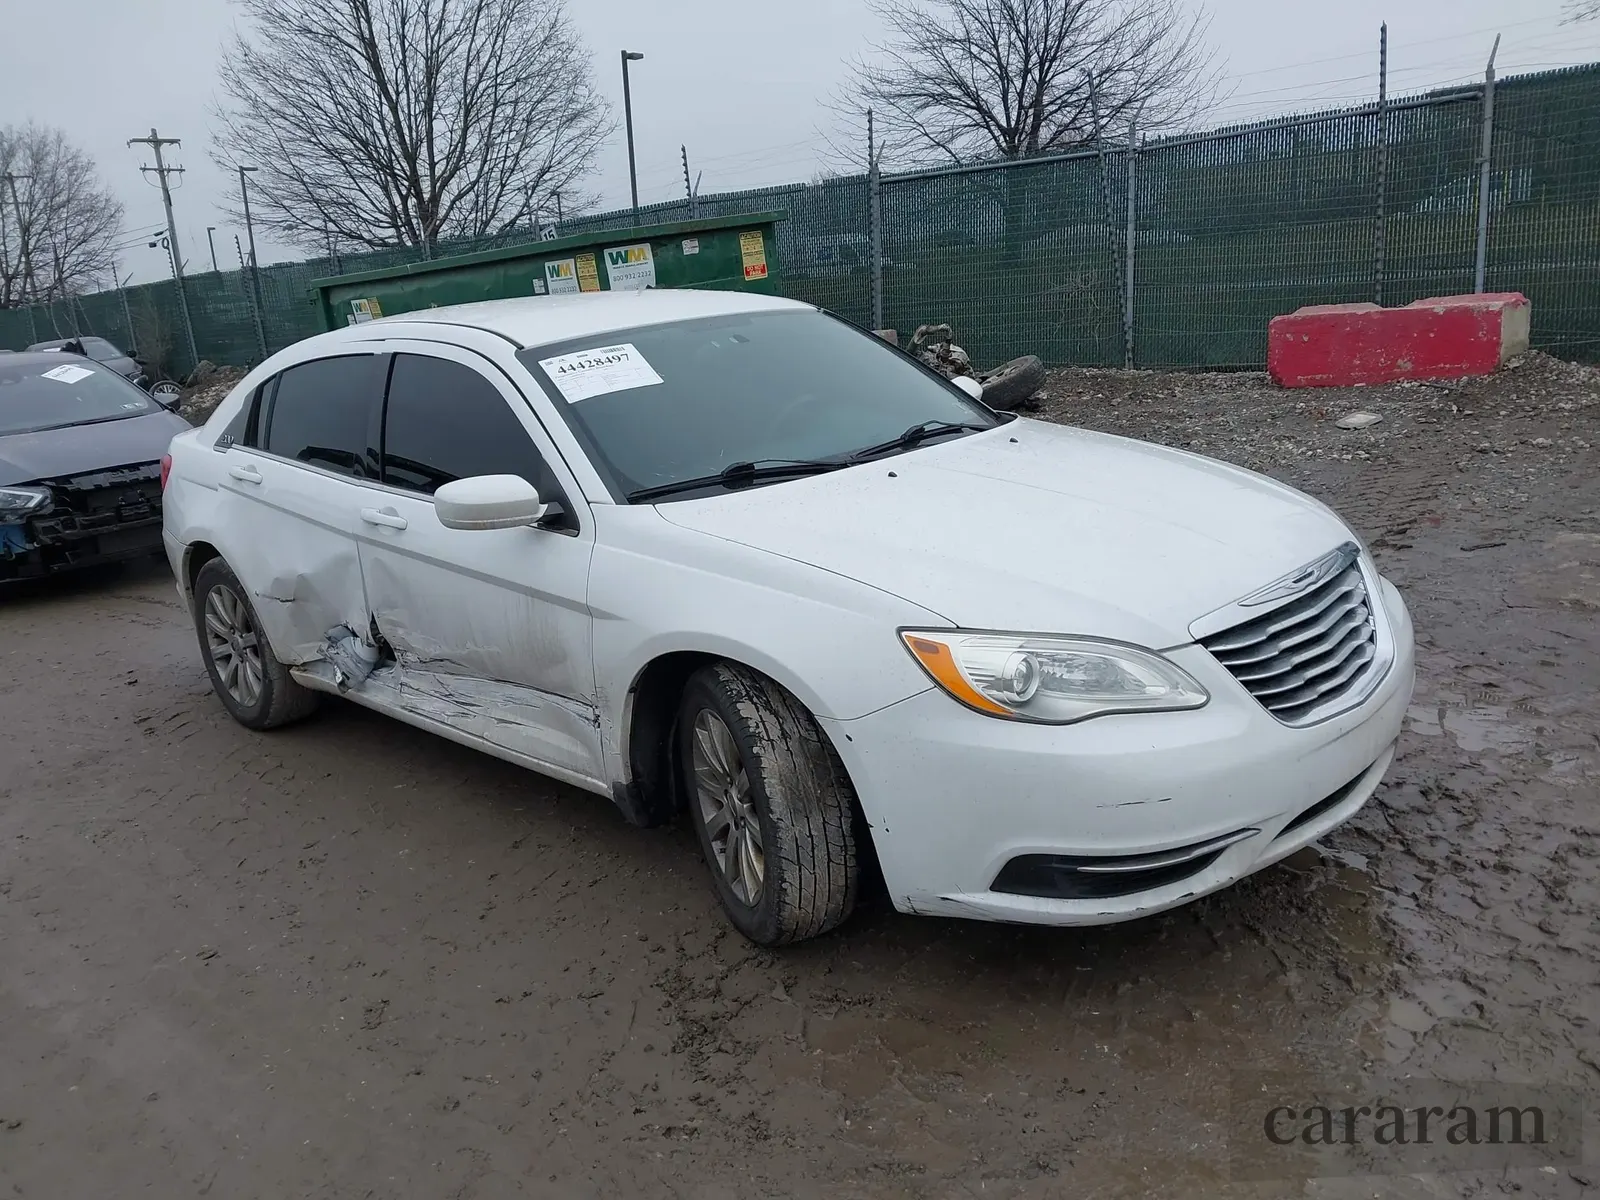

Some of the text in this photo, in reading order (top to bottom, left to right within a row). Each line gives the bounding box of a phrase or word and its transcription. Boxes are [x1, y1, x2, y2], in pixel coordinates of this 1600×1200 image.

[544, 229, 554, 240] 15
[608, 248, 648, 265] WM
[547, 263, 573, 278] WM
[624, 272, 636, 280] 932
[637, 270, 652, 278] 2232
[557, 354, 630, 374] 44428497
